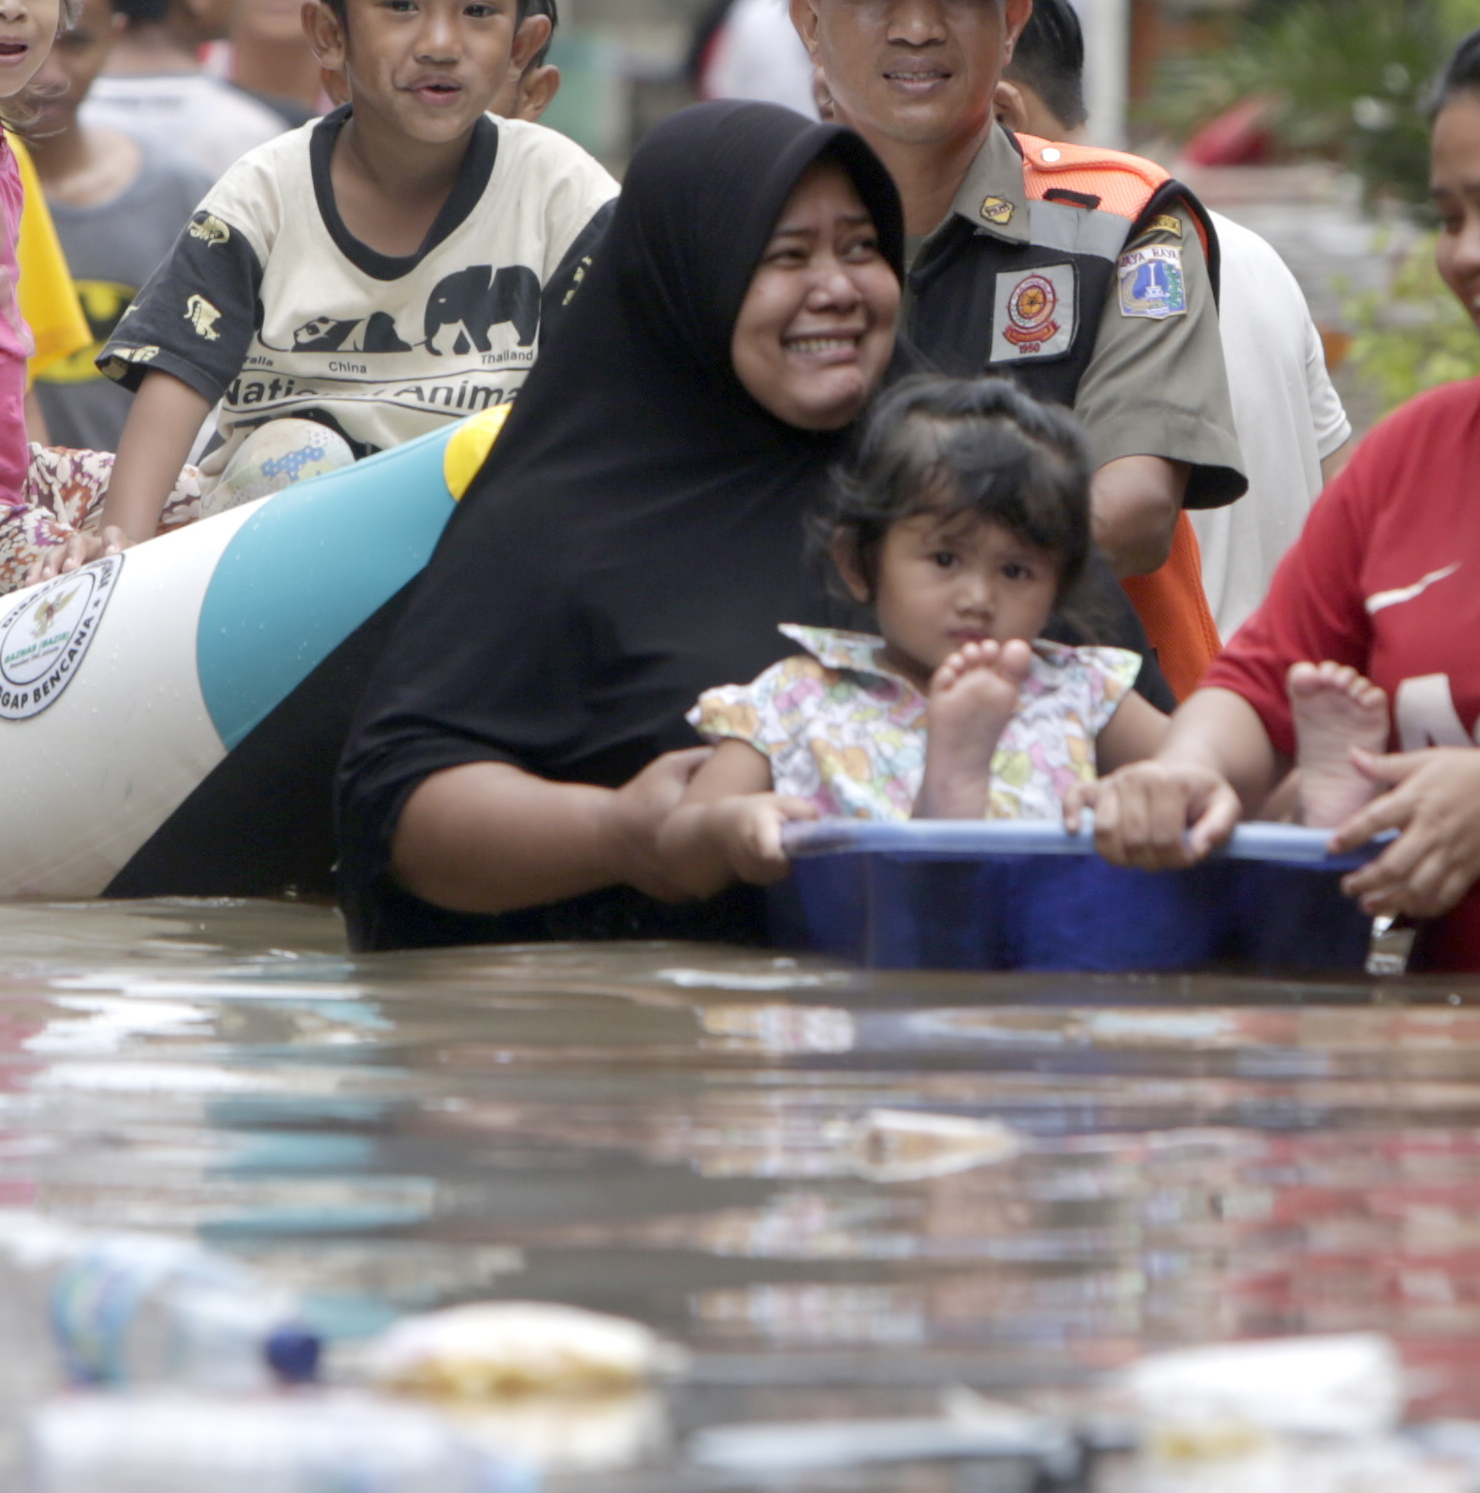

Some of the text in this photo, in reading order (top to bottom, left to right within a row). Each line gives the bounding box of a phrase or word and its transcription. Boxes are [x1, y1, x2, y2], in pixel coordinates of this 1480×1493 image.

[1152, 248, 1178, 260] RAYA
[481, 349, 534, 365] Thailand
[328, 361, 367, 374] China
[32, 615, 95, 704] BENCANA
